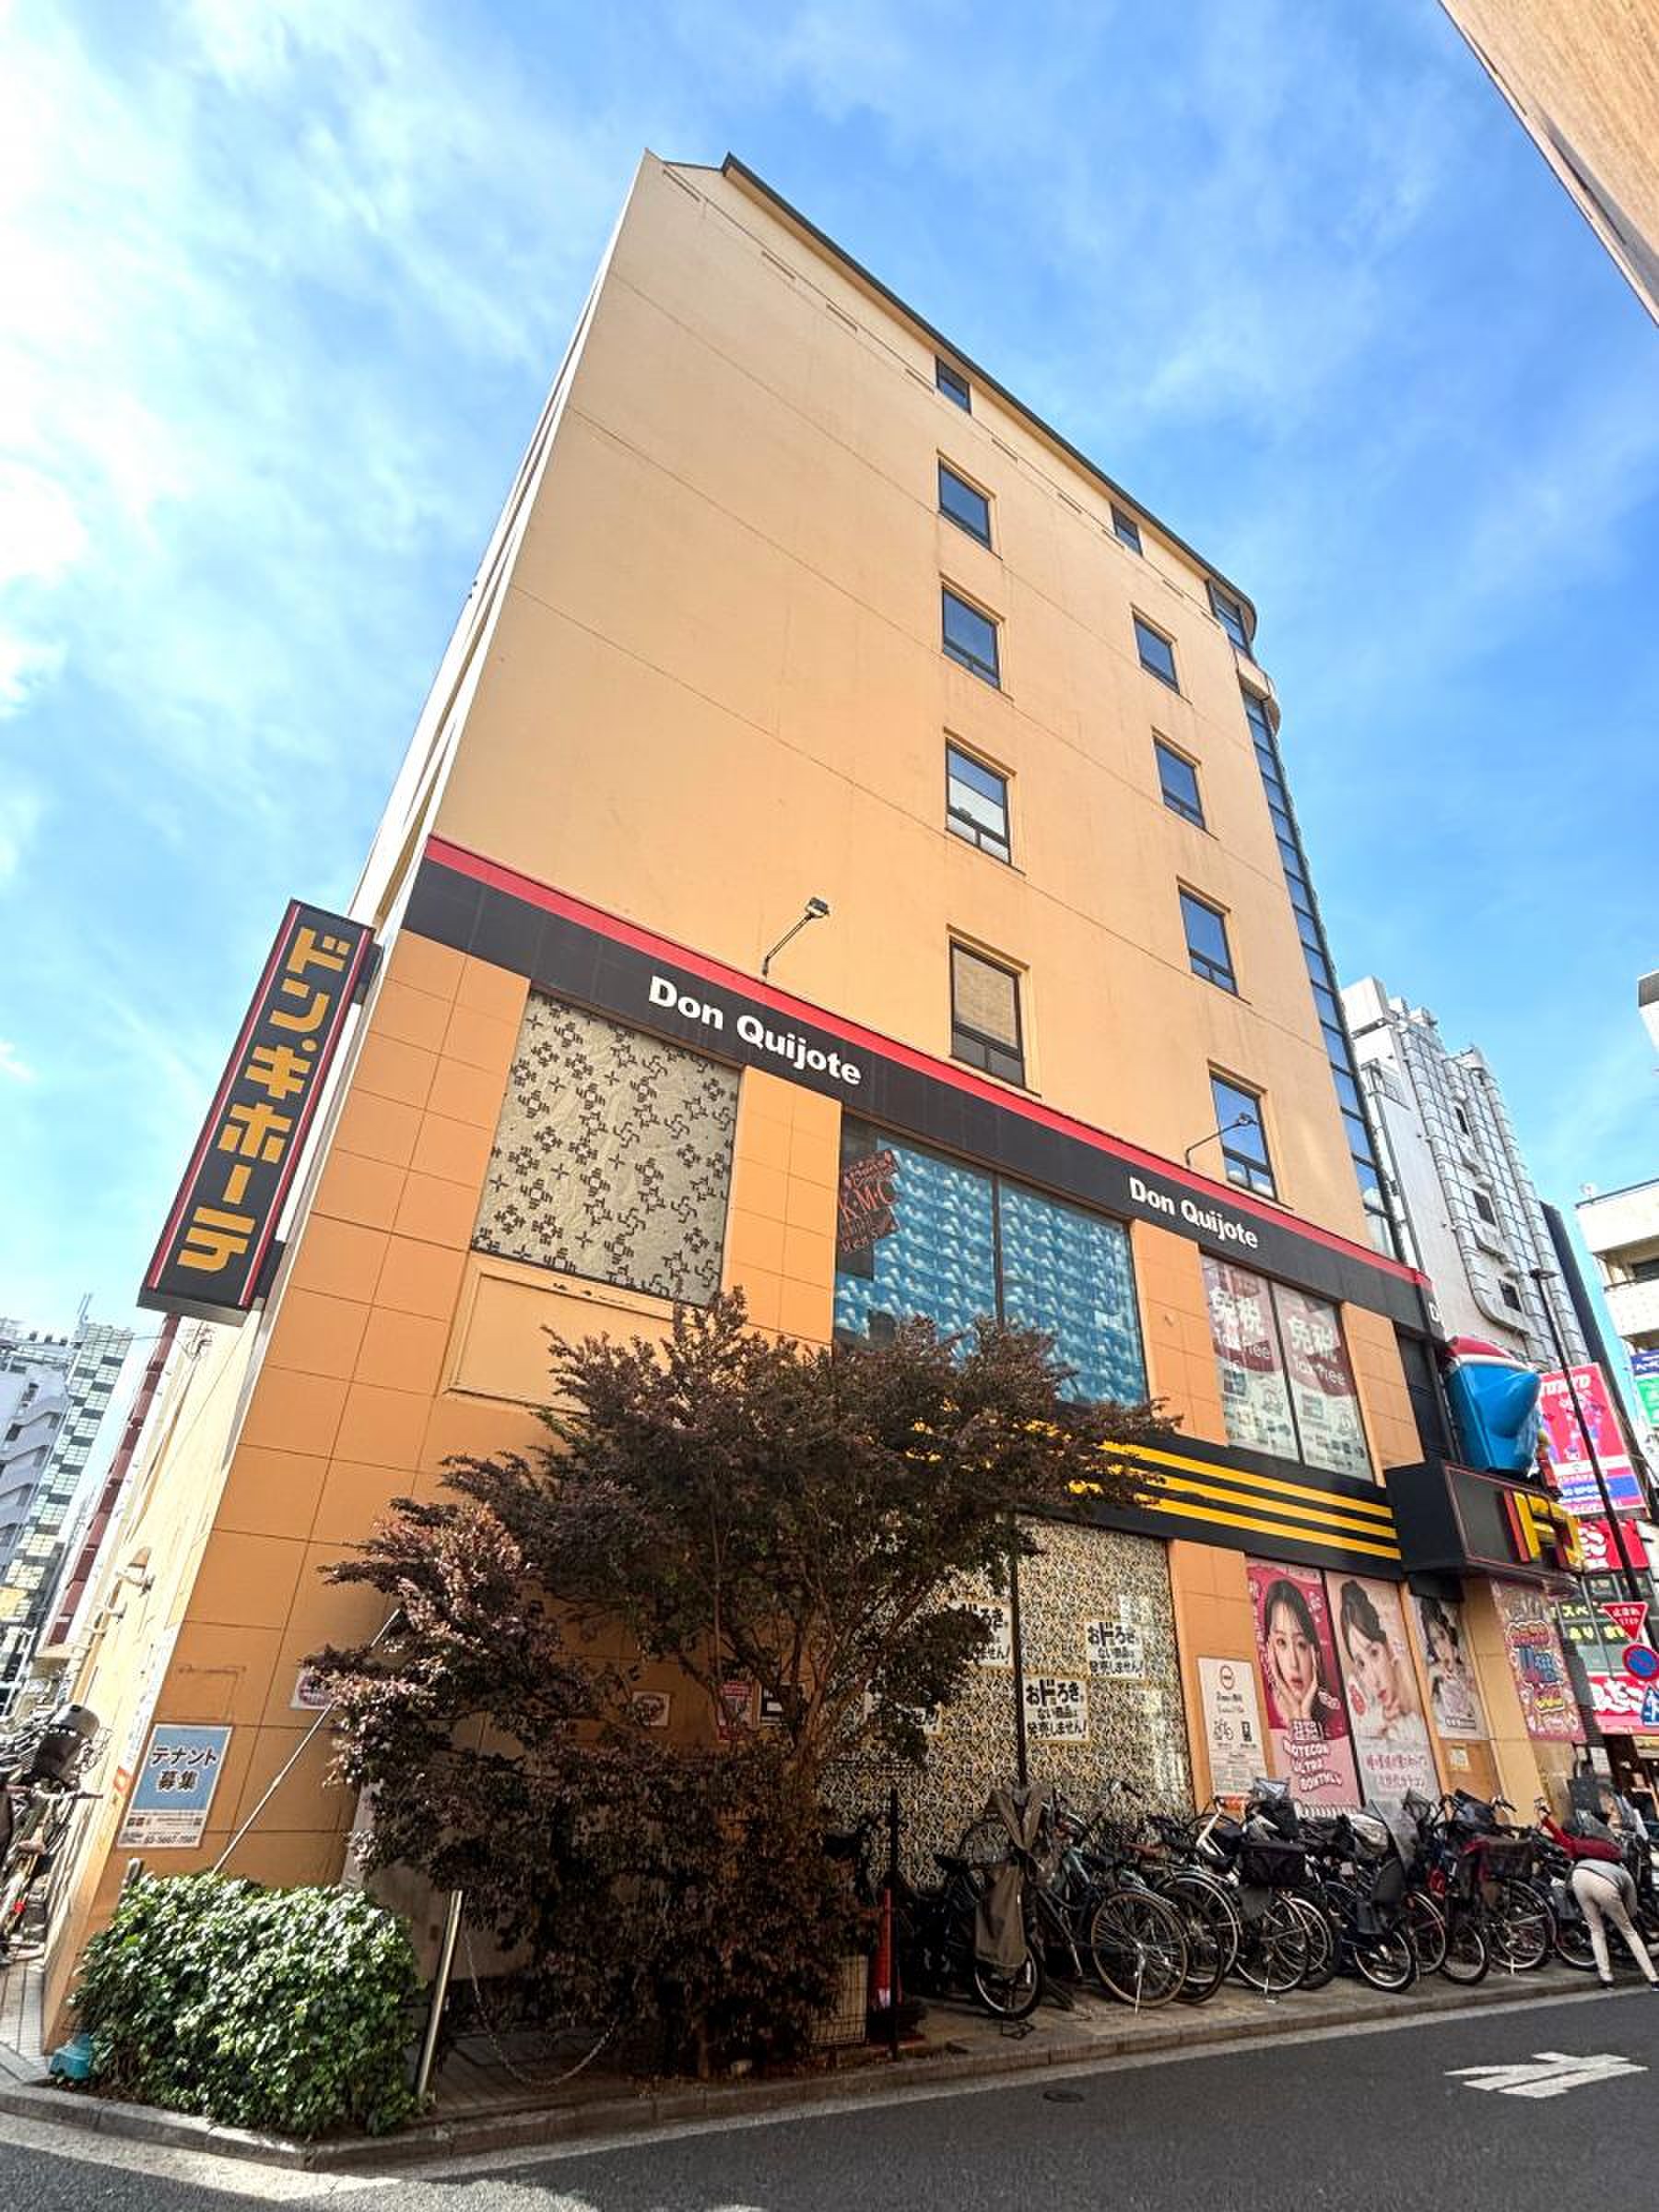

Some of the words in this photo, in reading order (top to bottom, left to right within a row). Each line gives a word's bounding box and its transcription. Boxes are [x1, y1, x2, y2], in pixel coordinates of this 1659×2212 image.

[648, 975, 724, 1030] Don
[736, 1015, 862, 1086] Quijote
[1129, 1176, 1175, 1216] Don
[1181, 1199, 1258, 1249] Quijote
[151, 1746, 218, 1768] テナント
[158, 1770, 197, 1792] 募集
